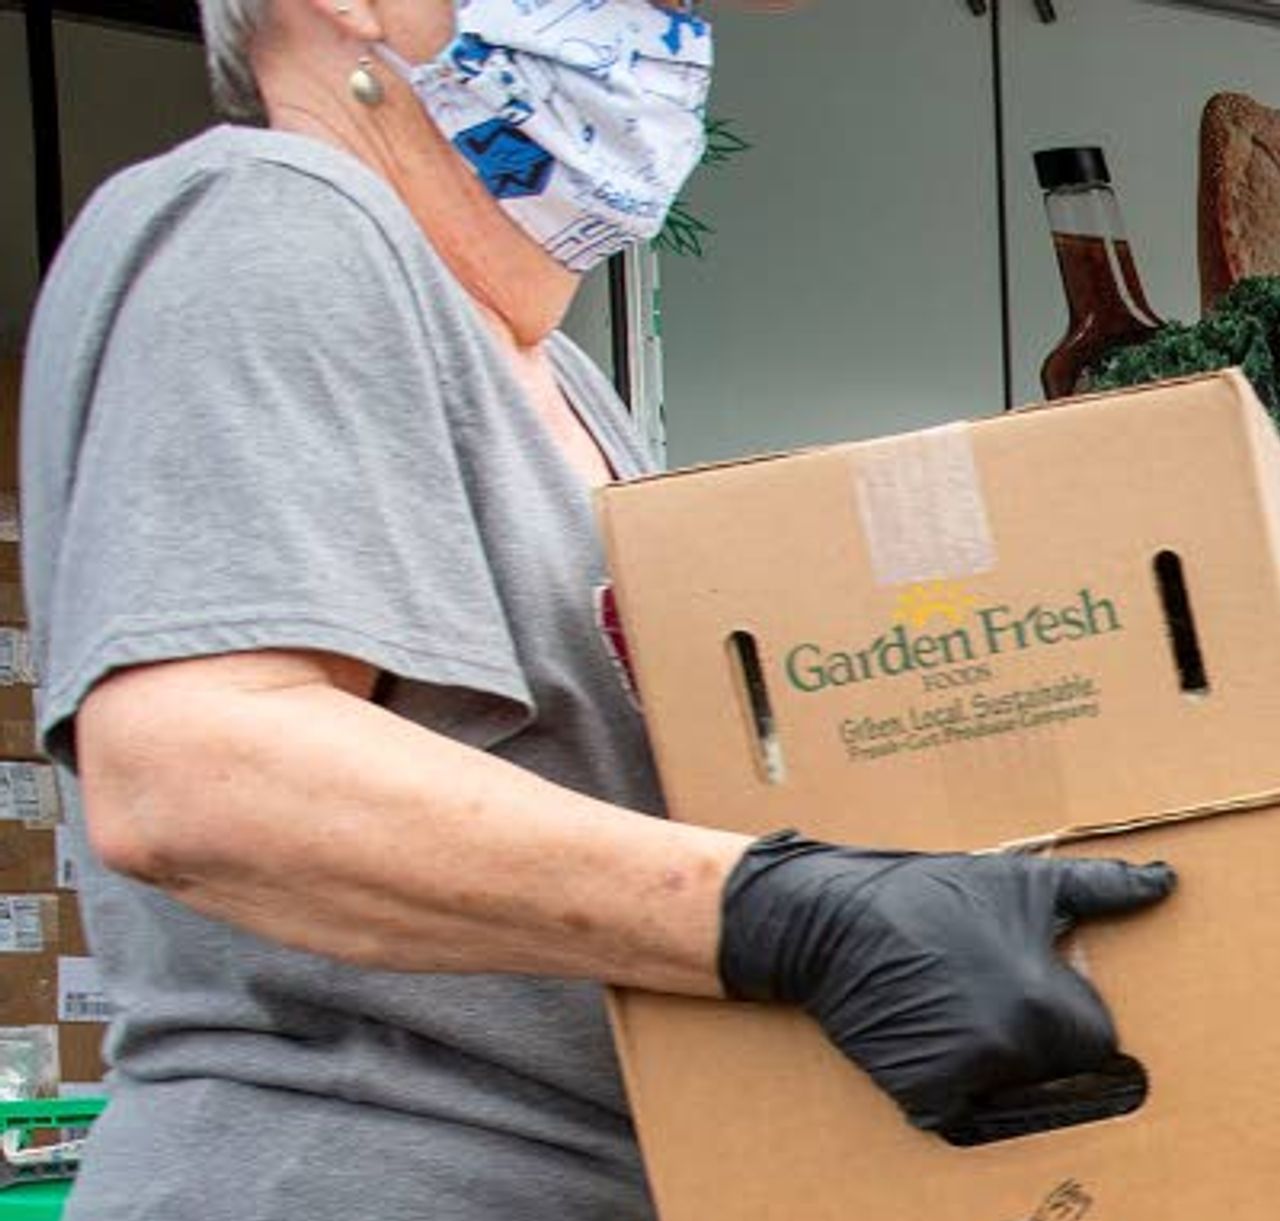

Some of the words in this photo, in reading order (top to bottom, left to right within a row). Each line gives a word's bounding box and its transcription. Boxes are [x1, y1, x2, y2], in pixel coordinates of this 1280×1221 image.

[784, 624, 976, 693] Garden
[976, 588, 1123, 654] Fresh
[922, 662, 993, 692] FOODS
